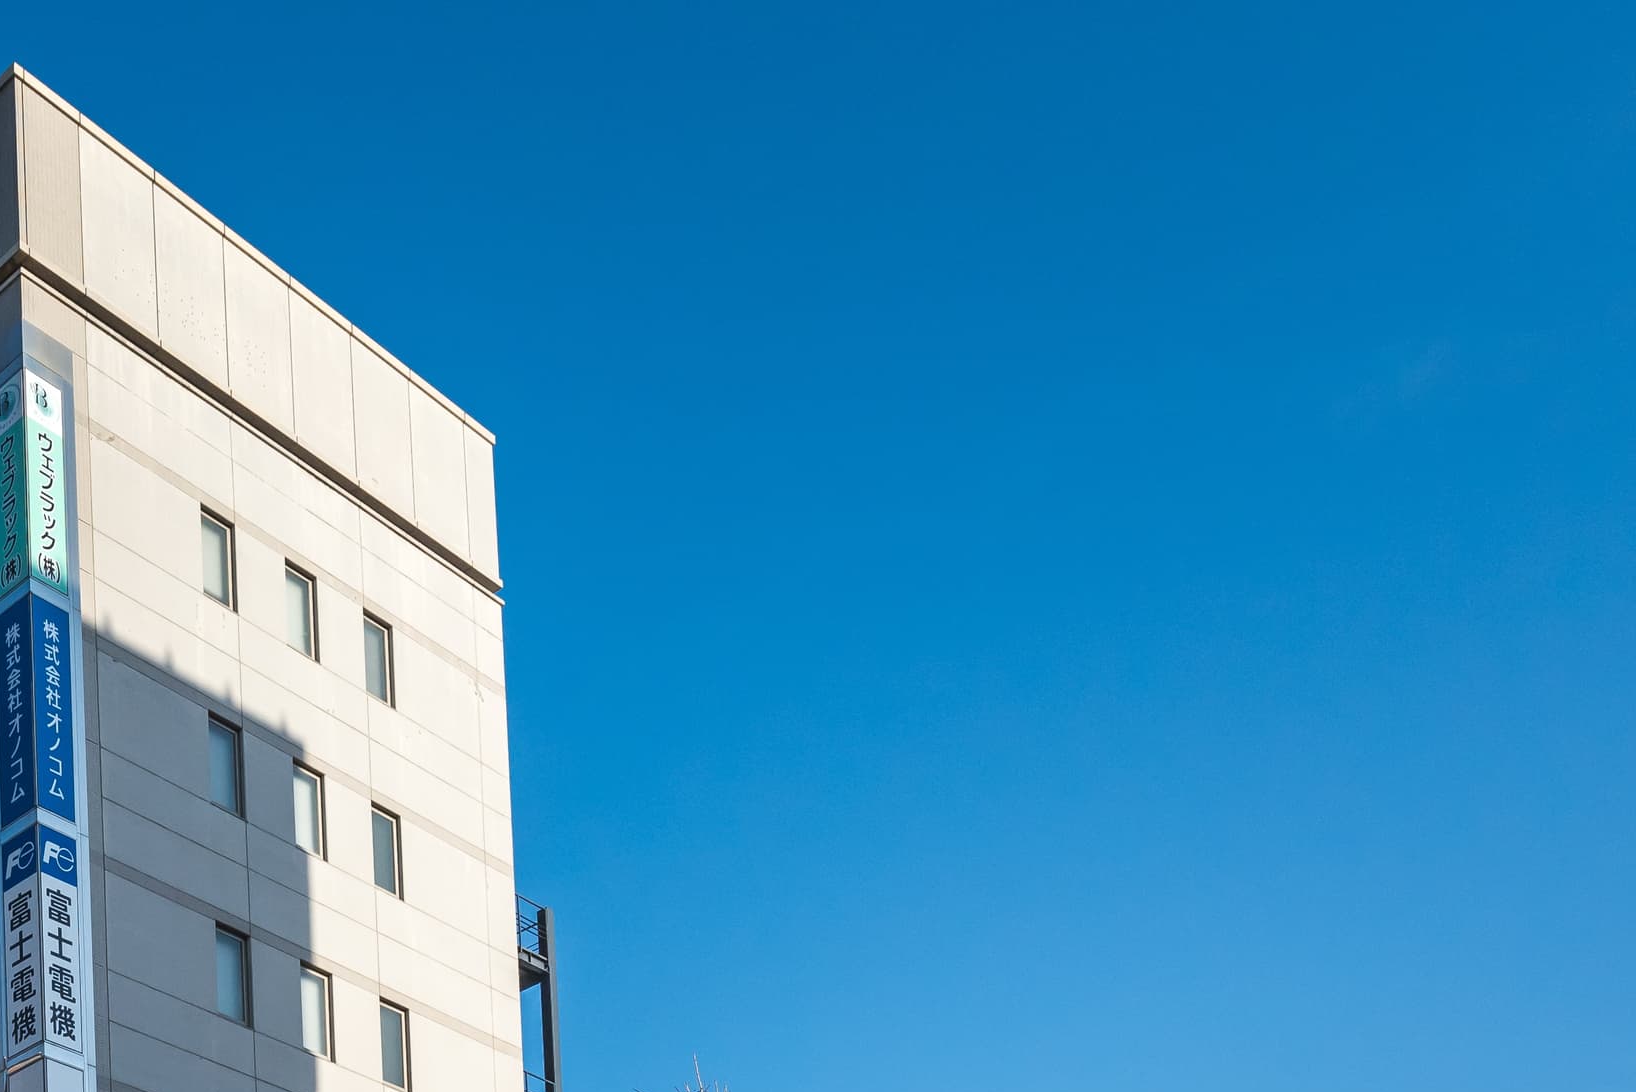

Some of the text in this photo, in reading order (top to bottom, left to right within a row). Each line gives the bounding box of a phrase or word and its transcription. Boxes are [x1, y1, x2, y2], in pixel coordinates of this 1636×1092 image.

[4, 622, 26, 804] 株式会社オノコム
[43, 618, 65, 801] 株式会社オノコム
[7, 888, 37, 1045] 富士電機
[46, 887, 76, 1041] 富士電機
